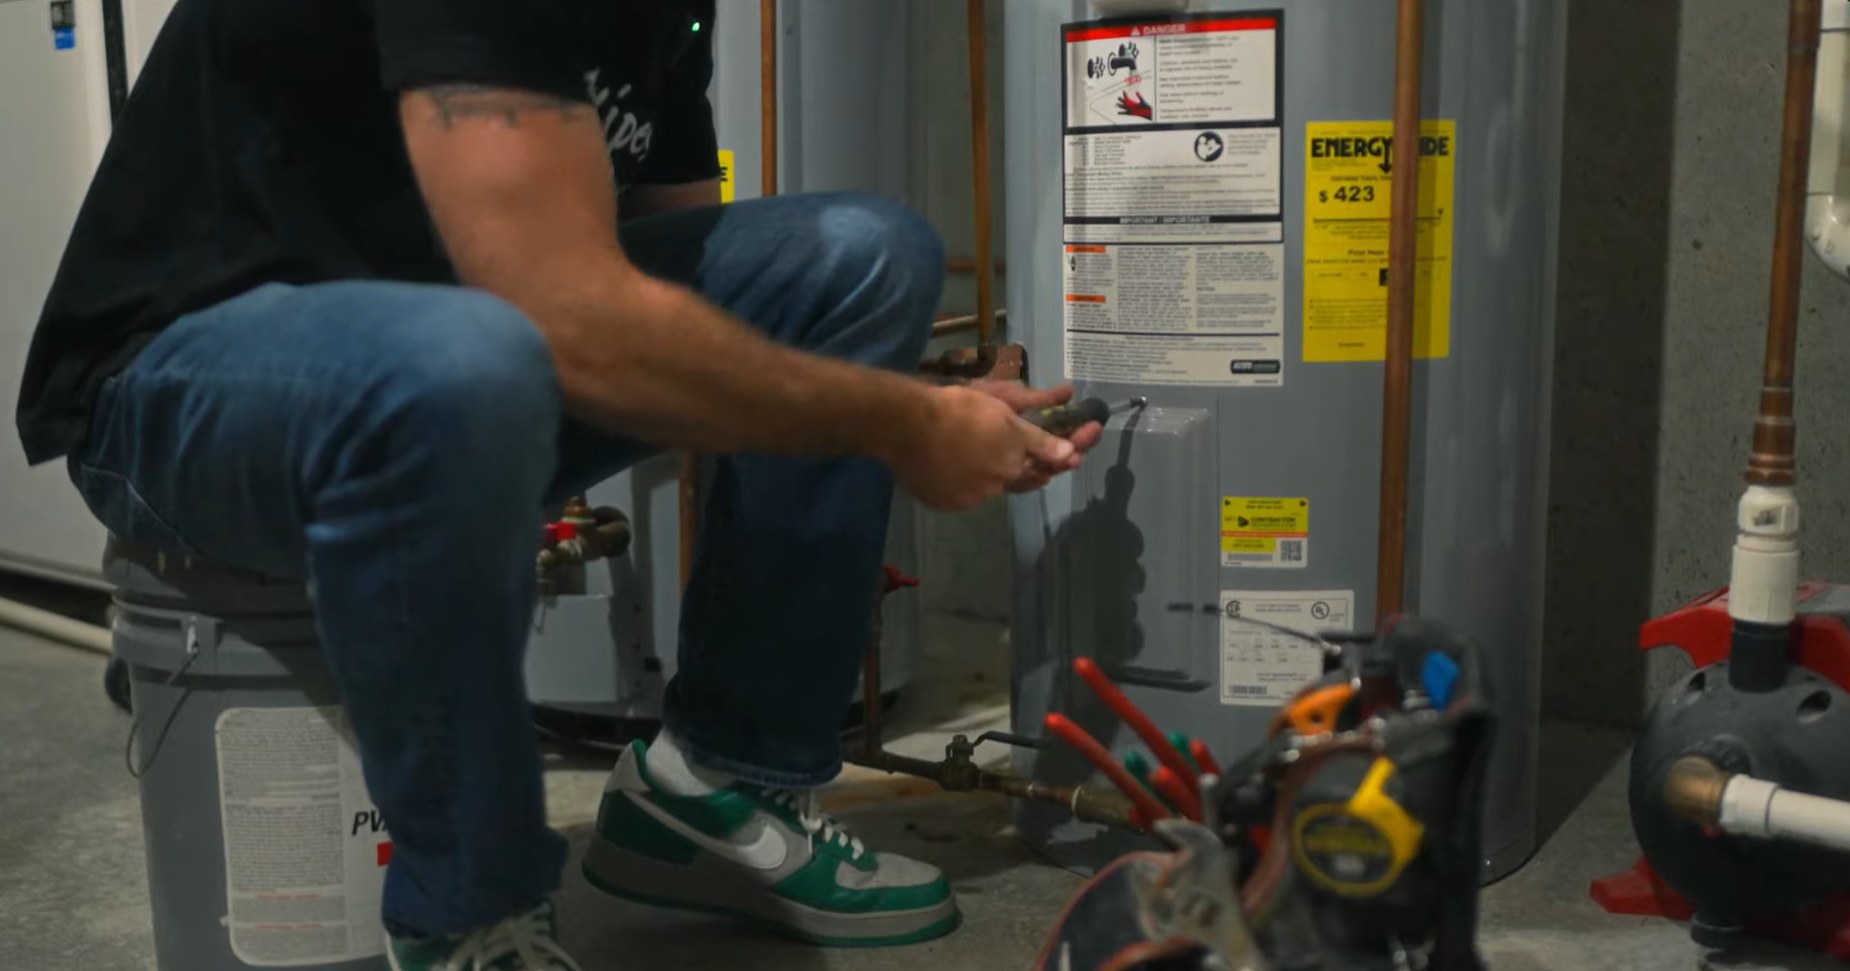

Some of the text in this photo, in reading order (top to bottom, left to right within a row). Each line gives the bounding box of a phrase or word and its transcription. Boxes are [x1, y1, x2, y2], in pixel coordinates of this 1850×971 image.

[1143, 24, 1186, 35] DANGER
[1319, 185, 1375, 203] $ 423
[1120, 216, 1157, 224] IMPORTANT
[352, 809, 388, 836] PV
